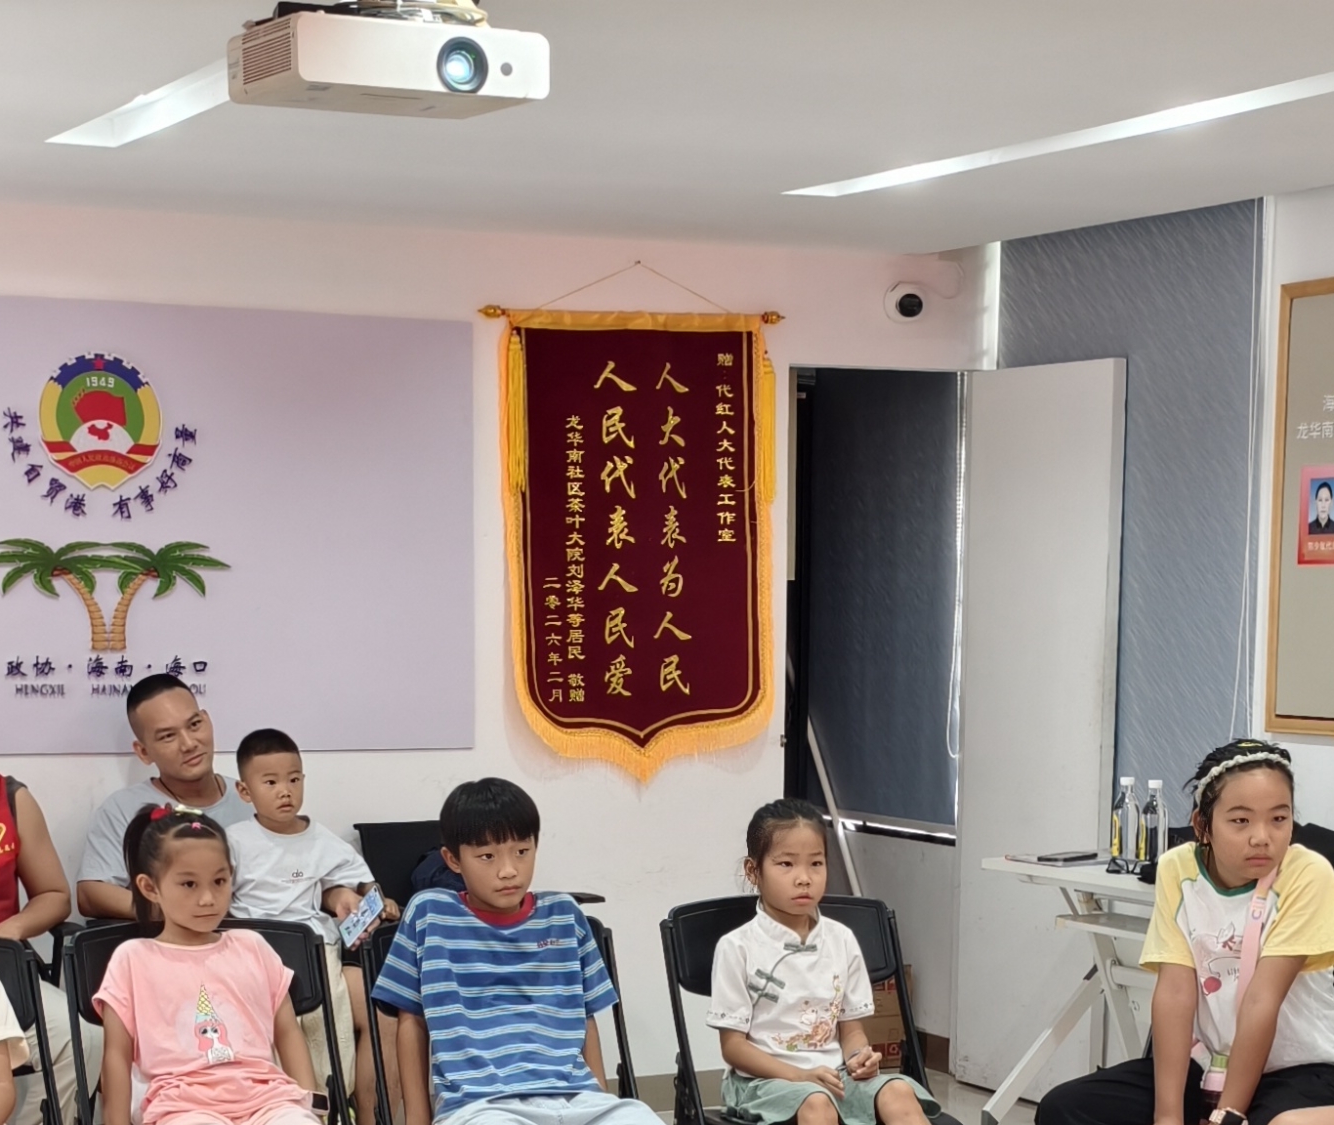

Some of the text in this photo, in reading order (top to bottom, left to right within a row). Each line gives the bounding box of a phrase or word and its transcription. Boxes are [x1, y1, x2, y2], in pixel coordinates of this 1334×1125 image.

[85, 376, 115, 388] 1949
[3, 407, 87, 517] 共建自贸港
[112, 424, 197, 519] 有事好商量
[594, 361, 639, 697] 人民代表人民爱
[653, 362, 692, 695] 人大代表为人民
[543, 577, 564, 703] 二零二六年二月
